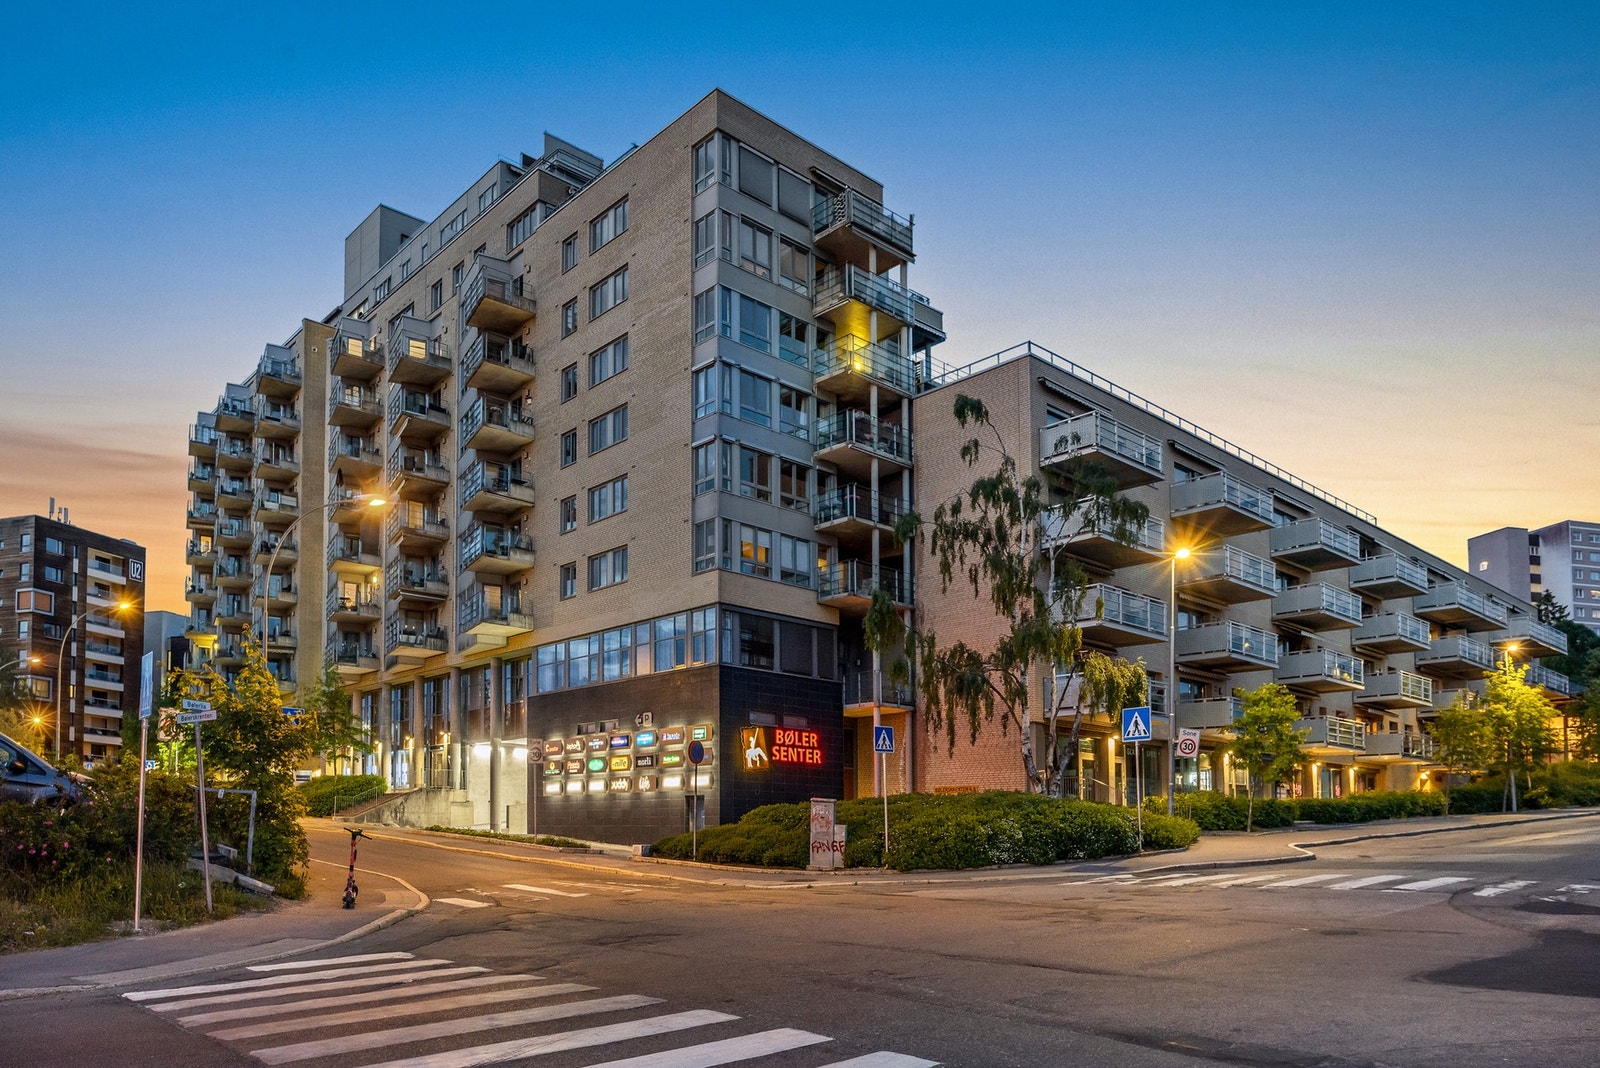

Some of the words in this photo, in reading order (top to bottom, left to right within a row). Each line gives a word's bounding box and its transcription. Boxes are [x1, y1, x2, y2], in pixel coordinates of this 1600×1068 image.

[131, 561, 141, 578] U2
[775, 729, 818, 747] BØLER
[1182, 742, 1193, 751] 30
[772, 745, 822, 764] SENTER
